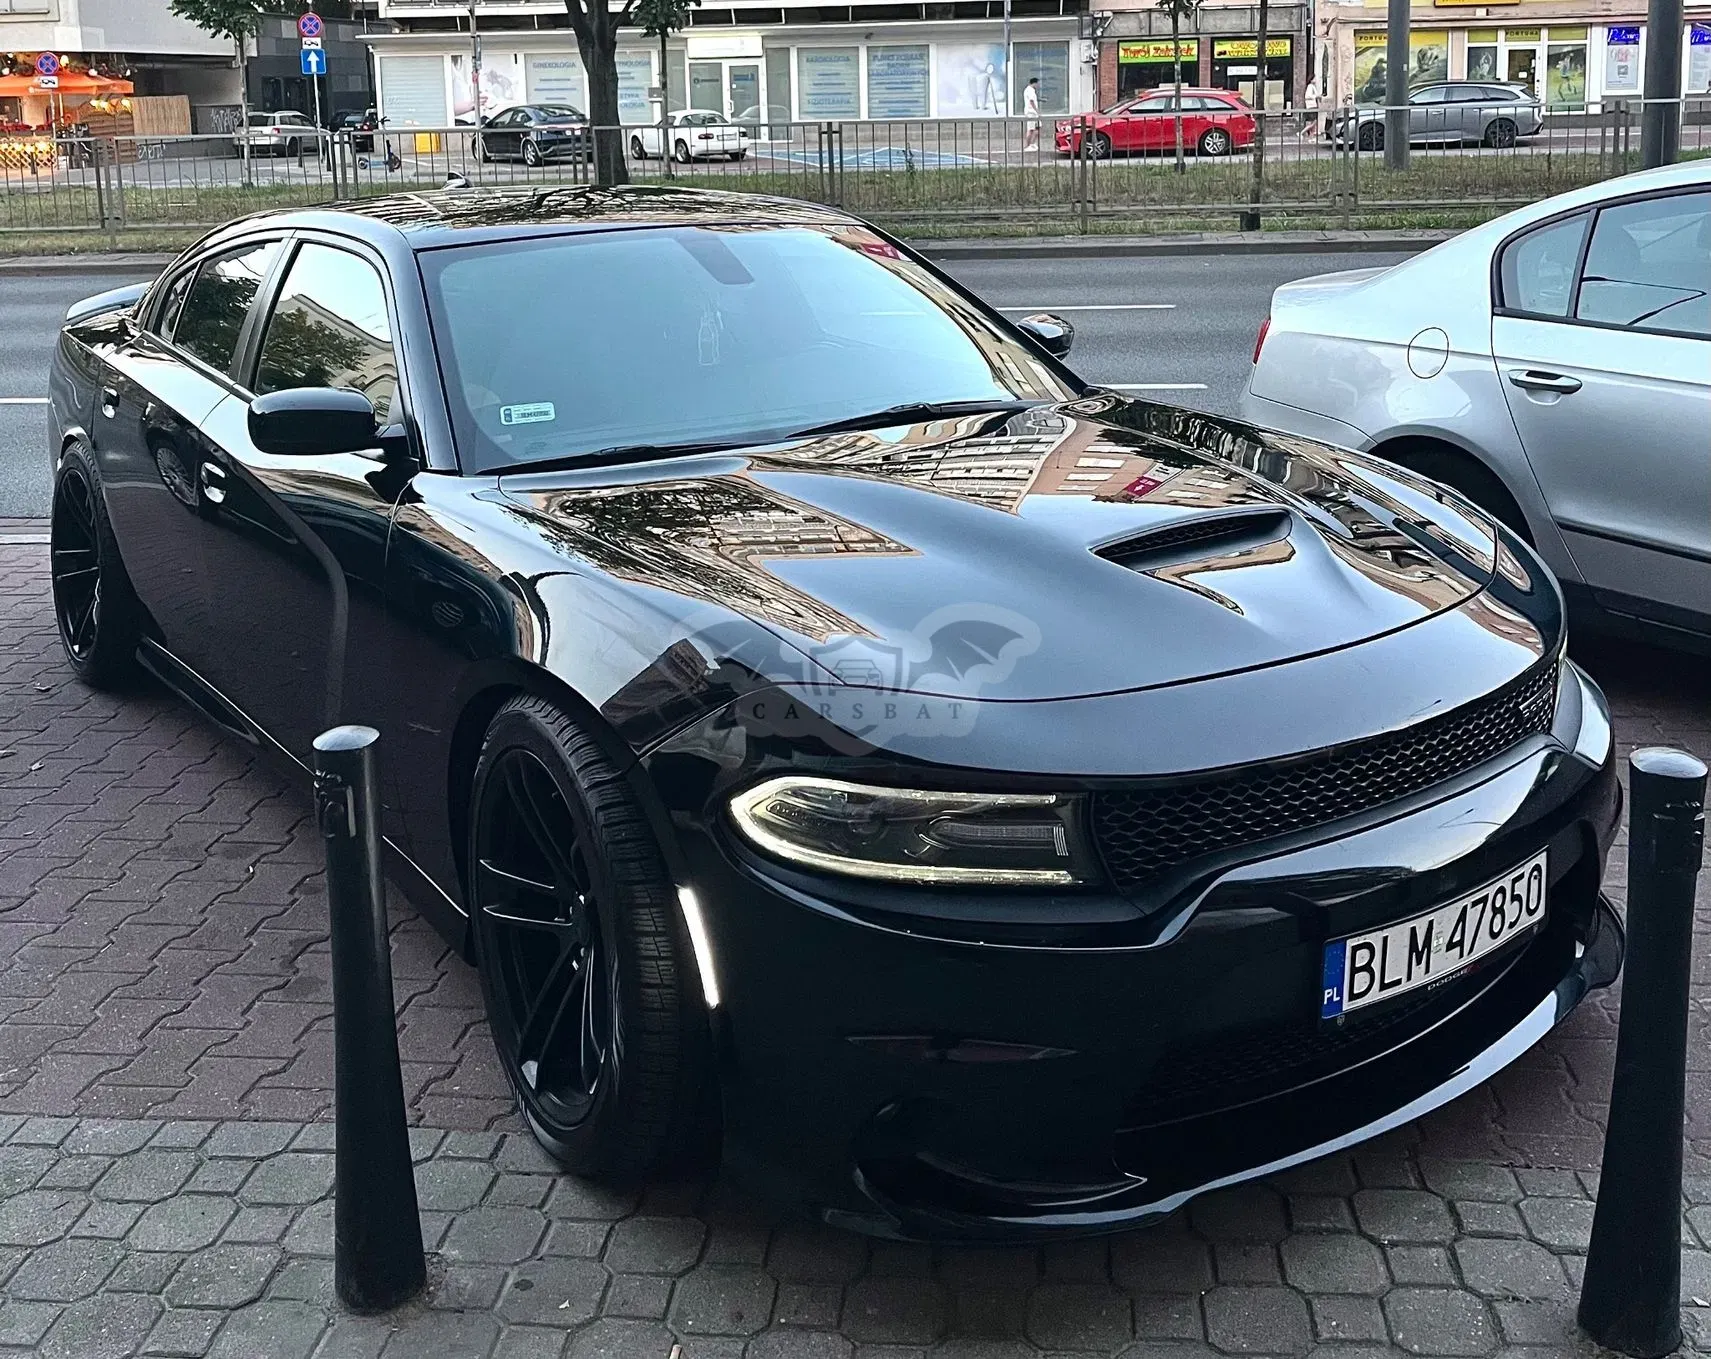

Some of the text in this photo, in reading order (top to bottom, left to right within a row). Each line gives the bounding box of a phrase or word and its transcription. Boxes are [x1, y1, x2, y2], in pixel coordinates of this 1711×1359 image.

[1121, 44, 1195, 58] Twój Zaktek
[533, 61, 577, 69] GINEKOLOGIA
[1348, 863, 1543, 1003] BLM 47850
[1427, 968, 1467, 991] DODGE
[1323, 988, 1341, 1005] PL
